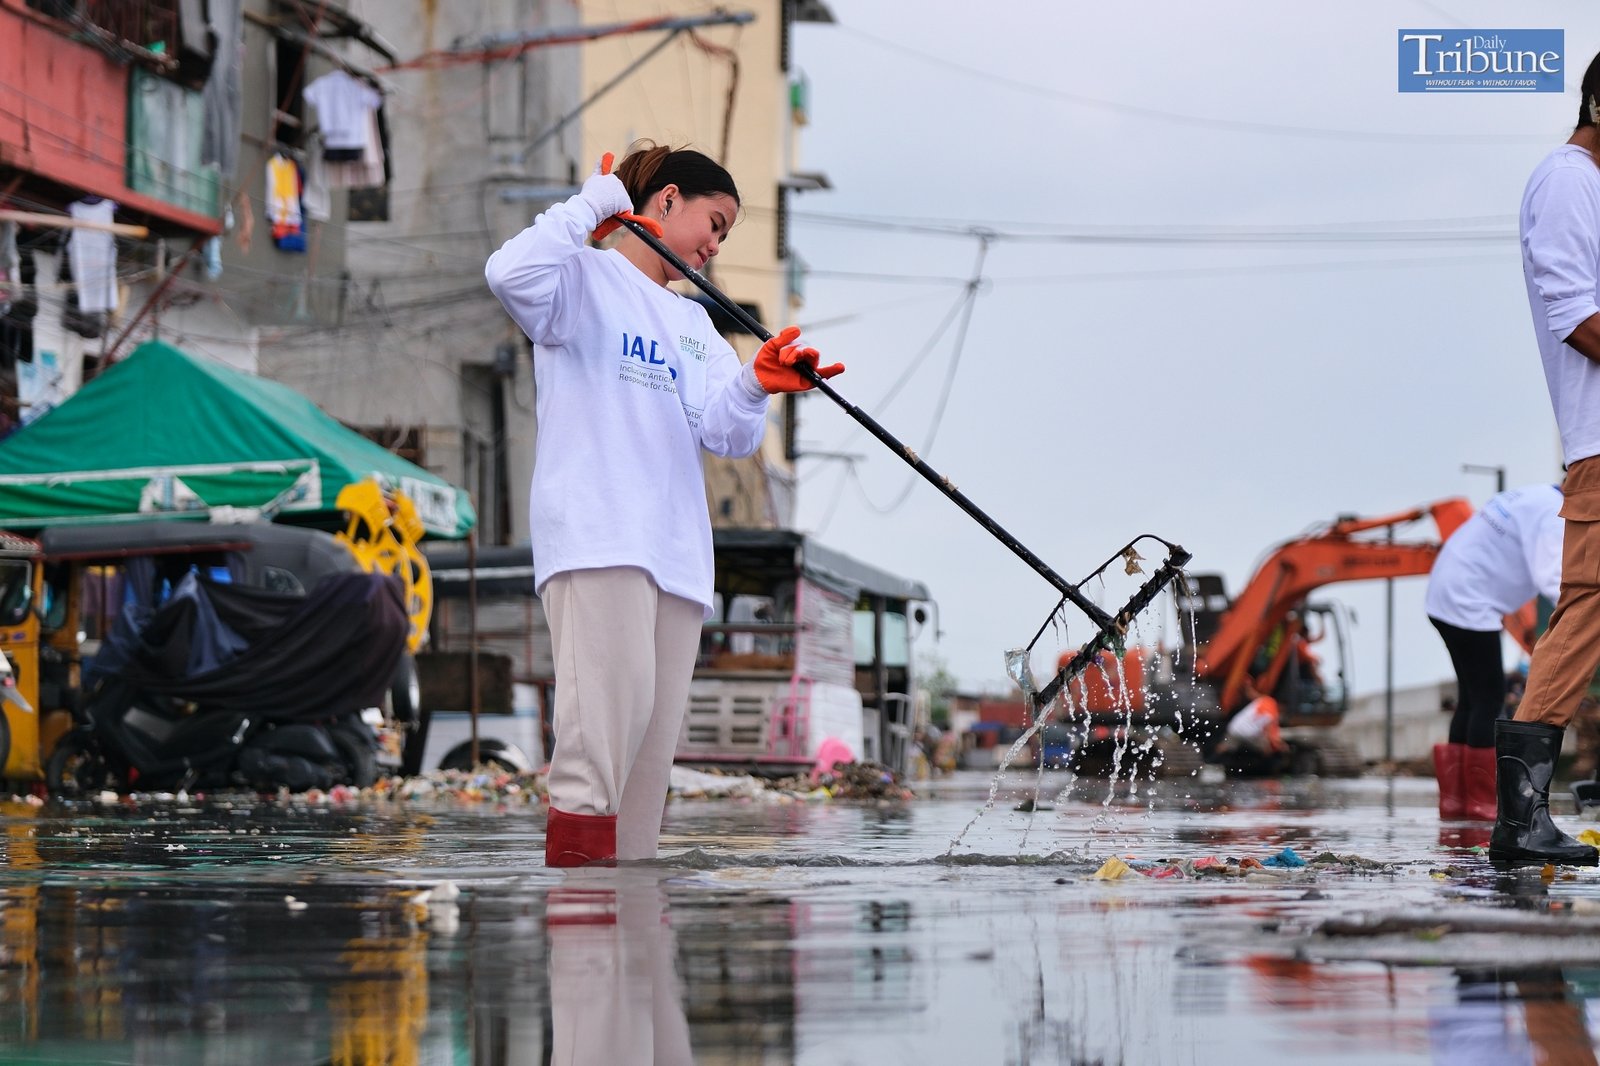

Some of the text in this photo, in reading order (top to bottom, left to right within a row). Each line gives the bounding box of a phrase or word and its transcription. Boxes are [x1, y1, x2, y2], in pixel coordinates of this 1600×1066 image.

[648, 372, 675, 384] Anticip
[650, 381, 661, 390] for
[663, 384, 678, 395] Sup
